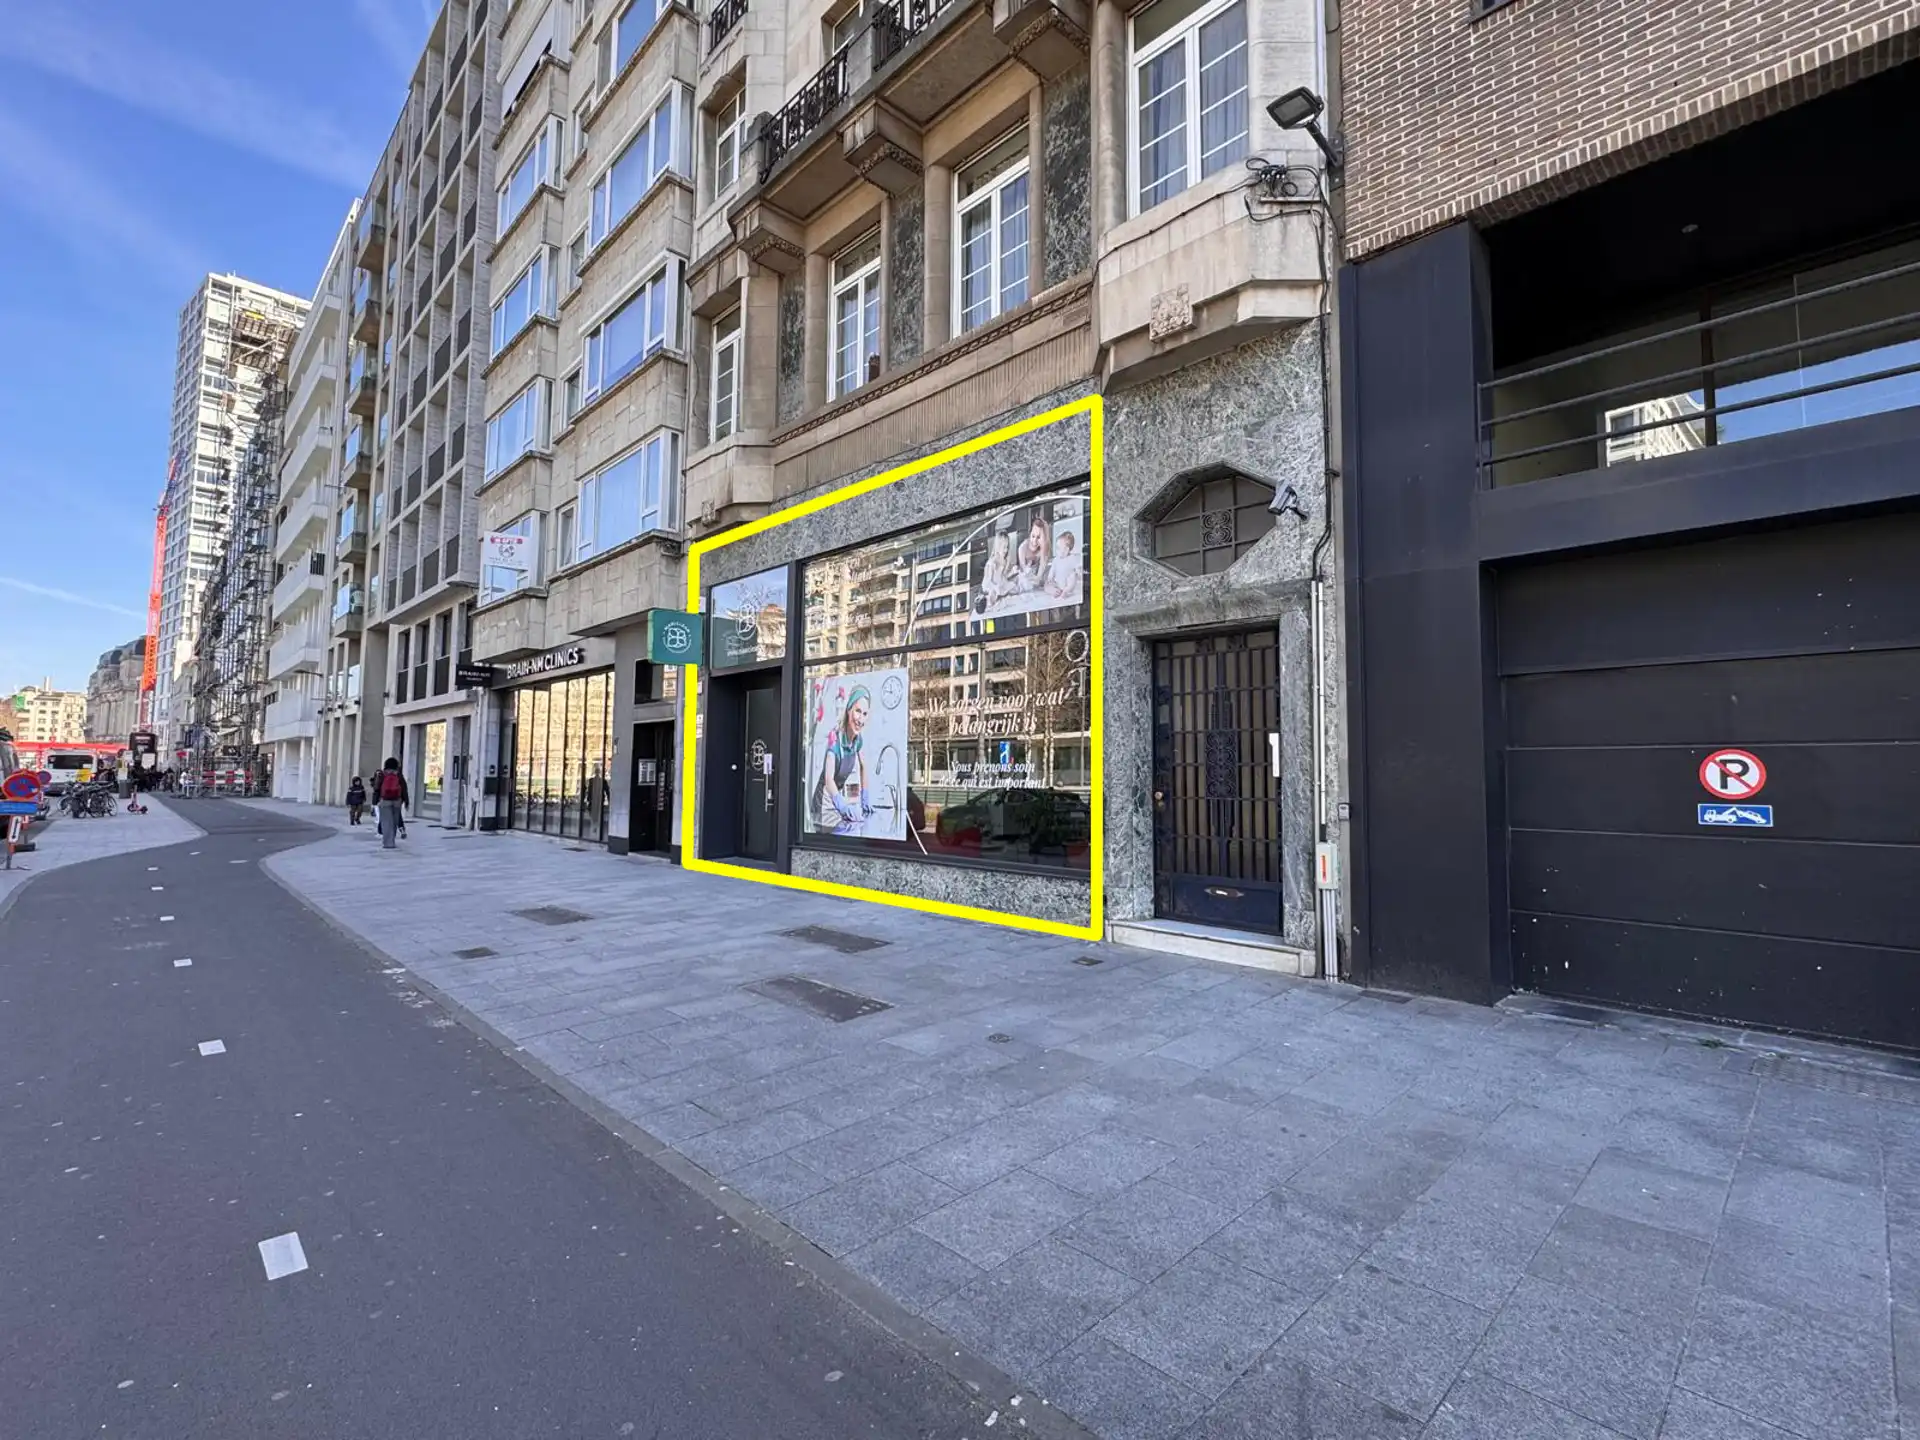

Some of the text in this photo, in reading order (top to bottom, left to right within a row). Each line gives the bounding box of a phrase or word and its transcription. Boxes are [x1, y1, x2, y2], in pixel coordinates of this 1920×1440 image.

[544, 647, 579, 671] CLINICS
[929, 696, 948, 713] We
[999, 694, 1032, 708] voor
[1035, 688, 1065, 706] wat
[951, 713, 1021, 737] belangrijk
[994, 776, 1046, 791] important
